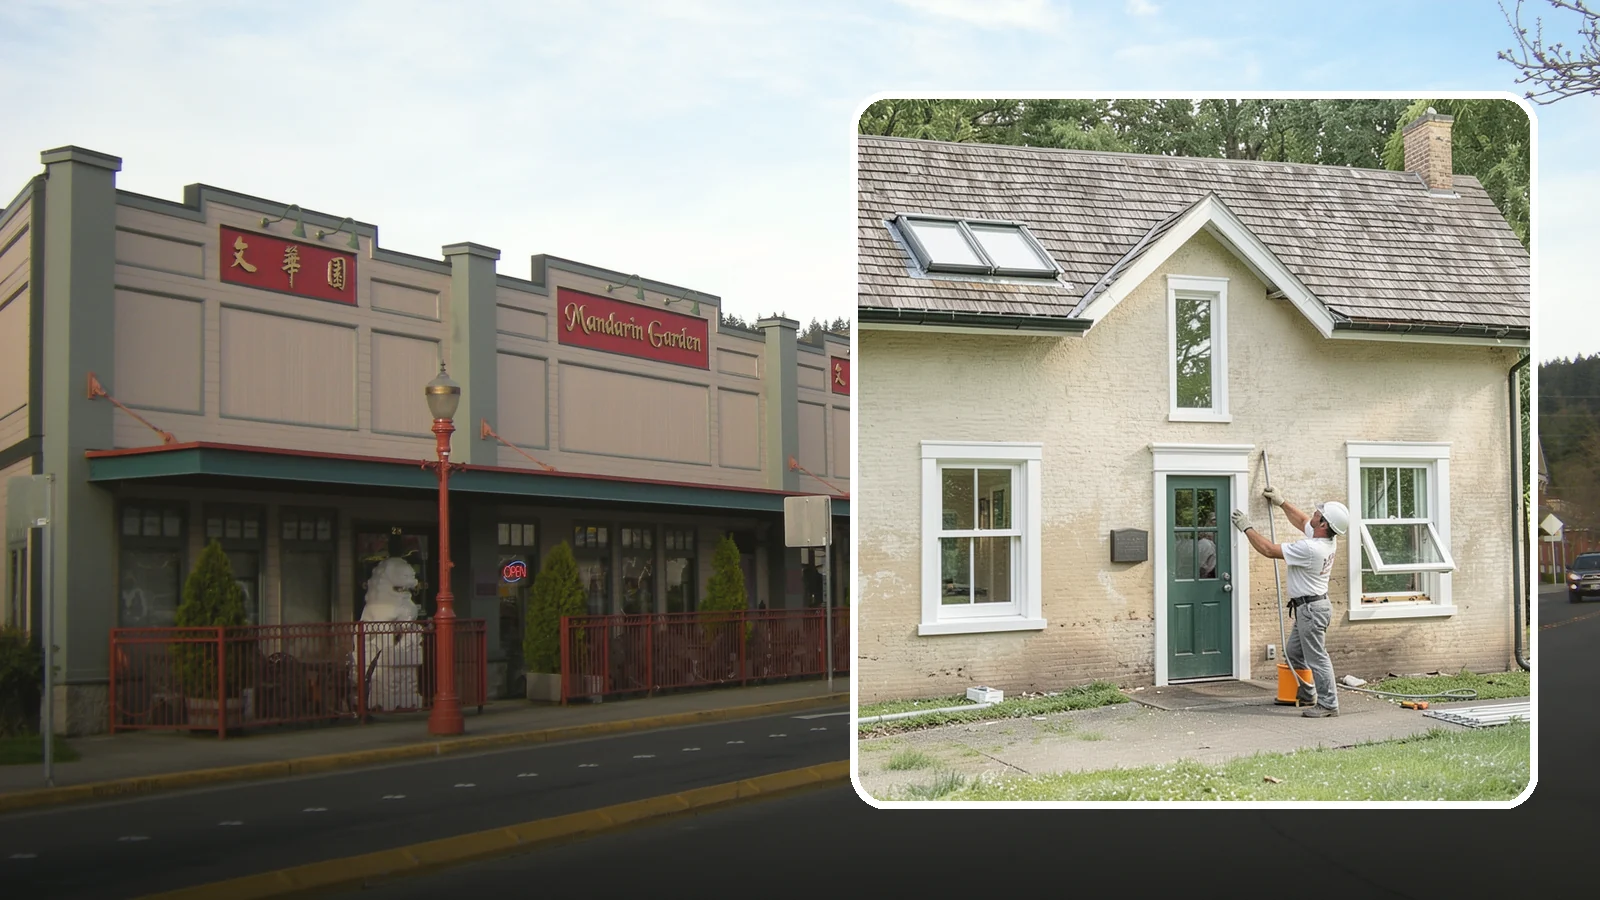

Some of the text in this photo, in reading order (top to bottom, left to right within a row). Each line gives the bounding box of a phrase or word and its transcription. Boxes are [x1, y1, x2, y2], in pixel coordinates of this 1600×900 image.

[231, 235, 346, 291] 文華園
[564, 302, 701, 352] Mandarin Garden
[503, 565, 527, 578] OPEN
